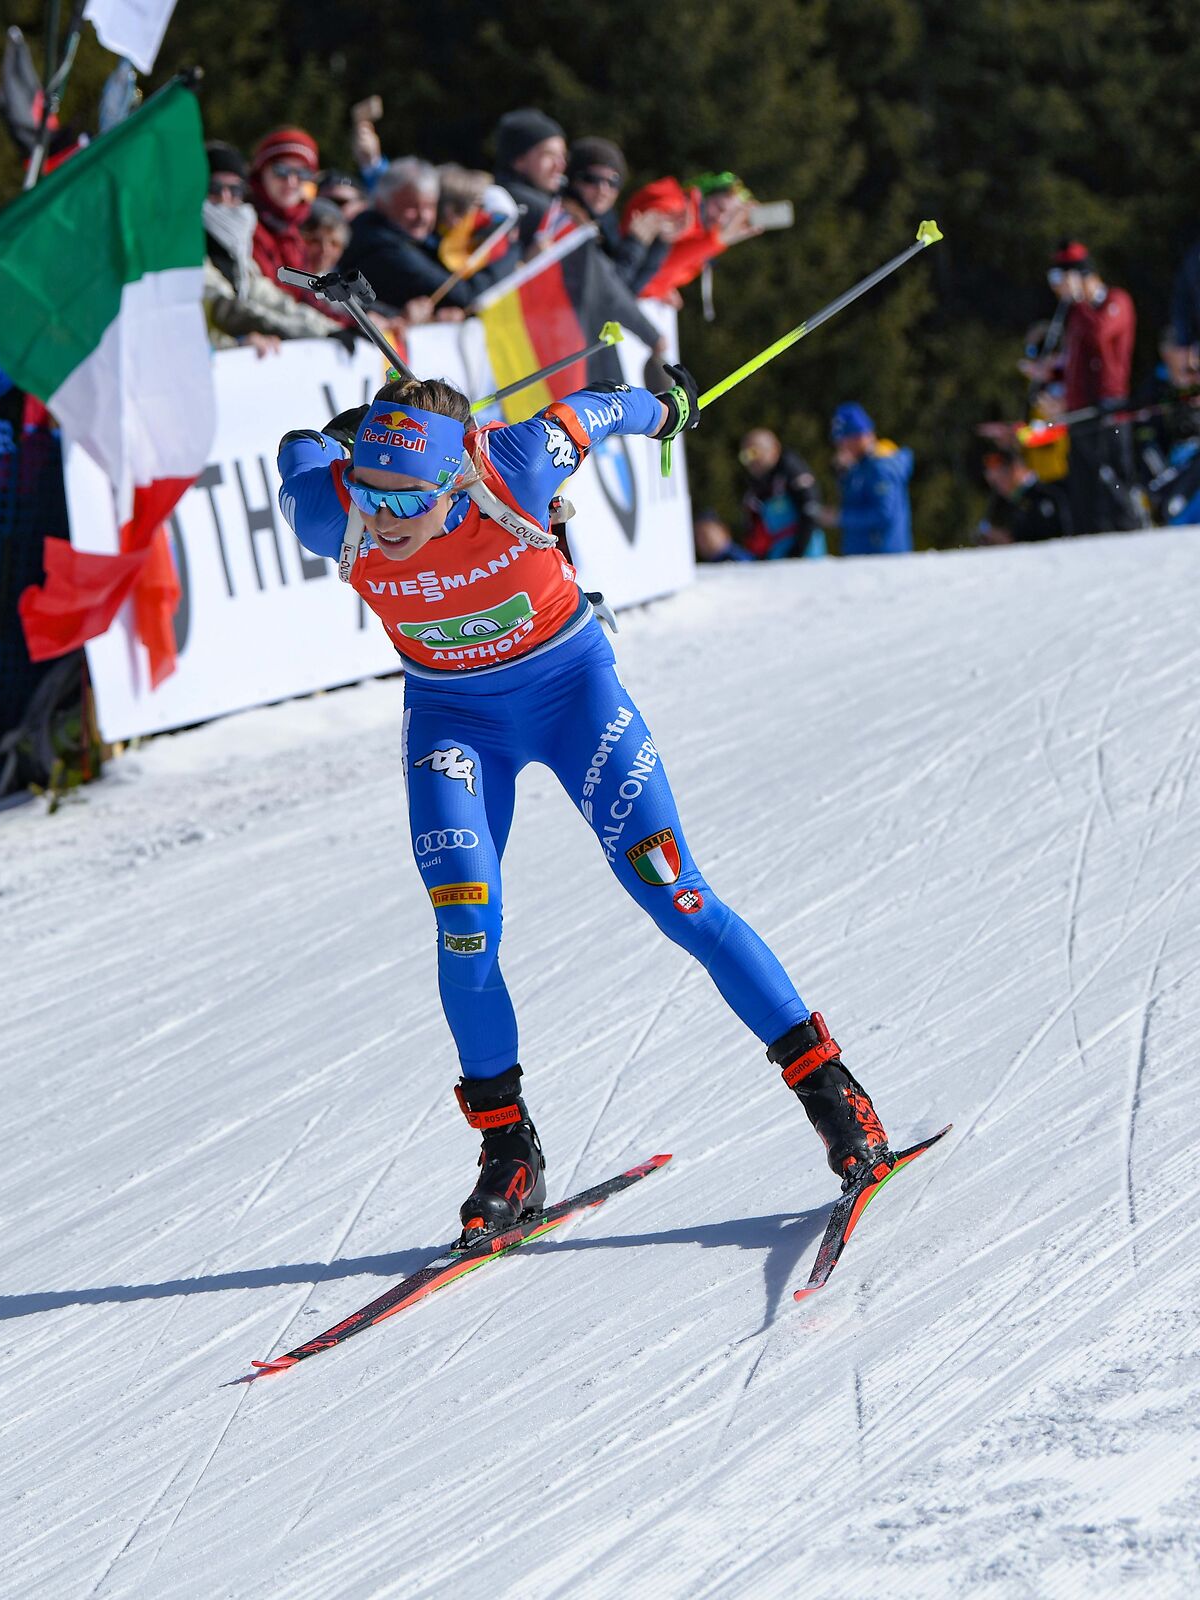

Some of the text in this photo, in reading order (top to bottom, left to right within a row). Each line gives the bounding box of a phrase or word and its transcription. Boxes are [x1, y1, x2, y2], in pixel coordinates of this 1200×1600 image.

[362, 428, 428, 454] Red Bull
[365, 538, 529, 603] VIESSMANN
[582, 705, 635, 798] sportful
[629, 831, 672, 859] ITALIA
[421, 856, 443, 871] Audi
[432, 886, 483, 904] PIRELLI
[445, 934, 485, 951] FORST
